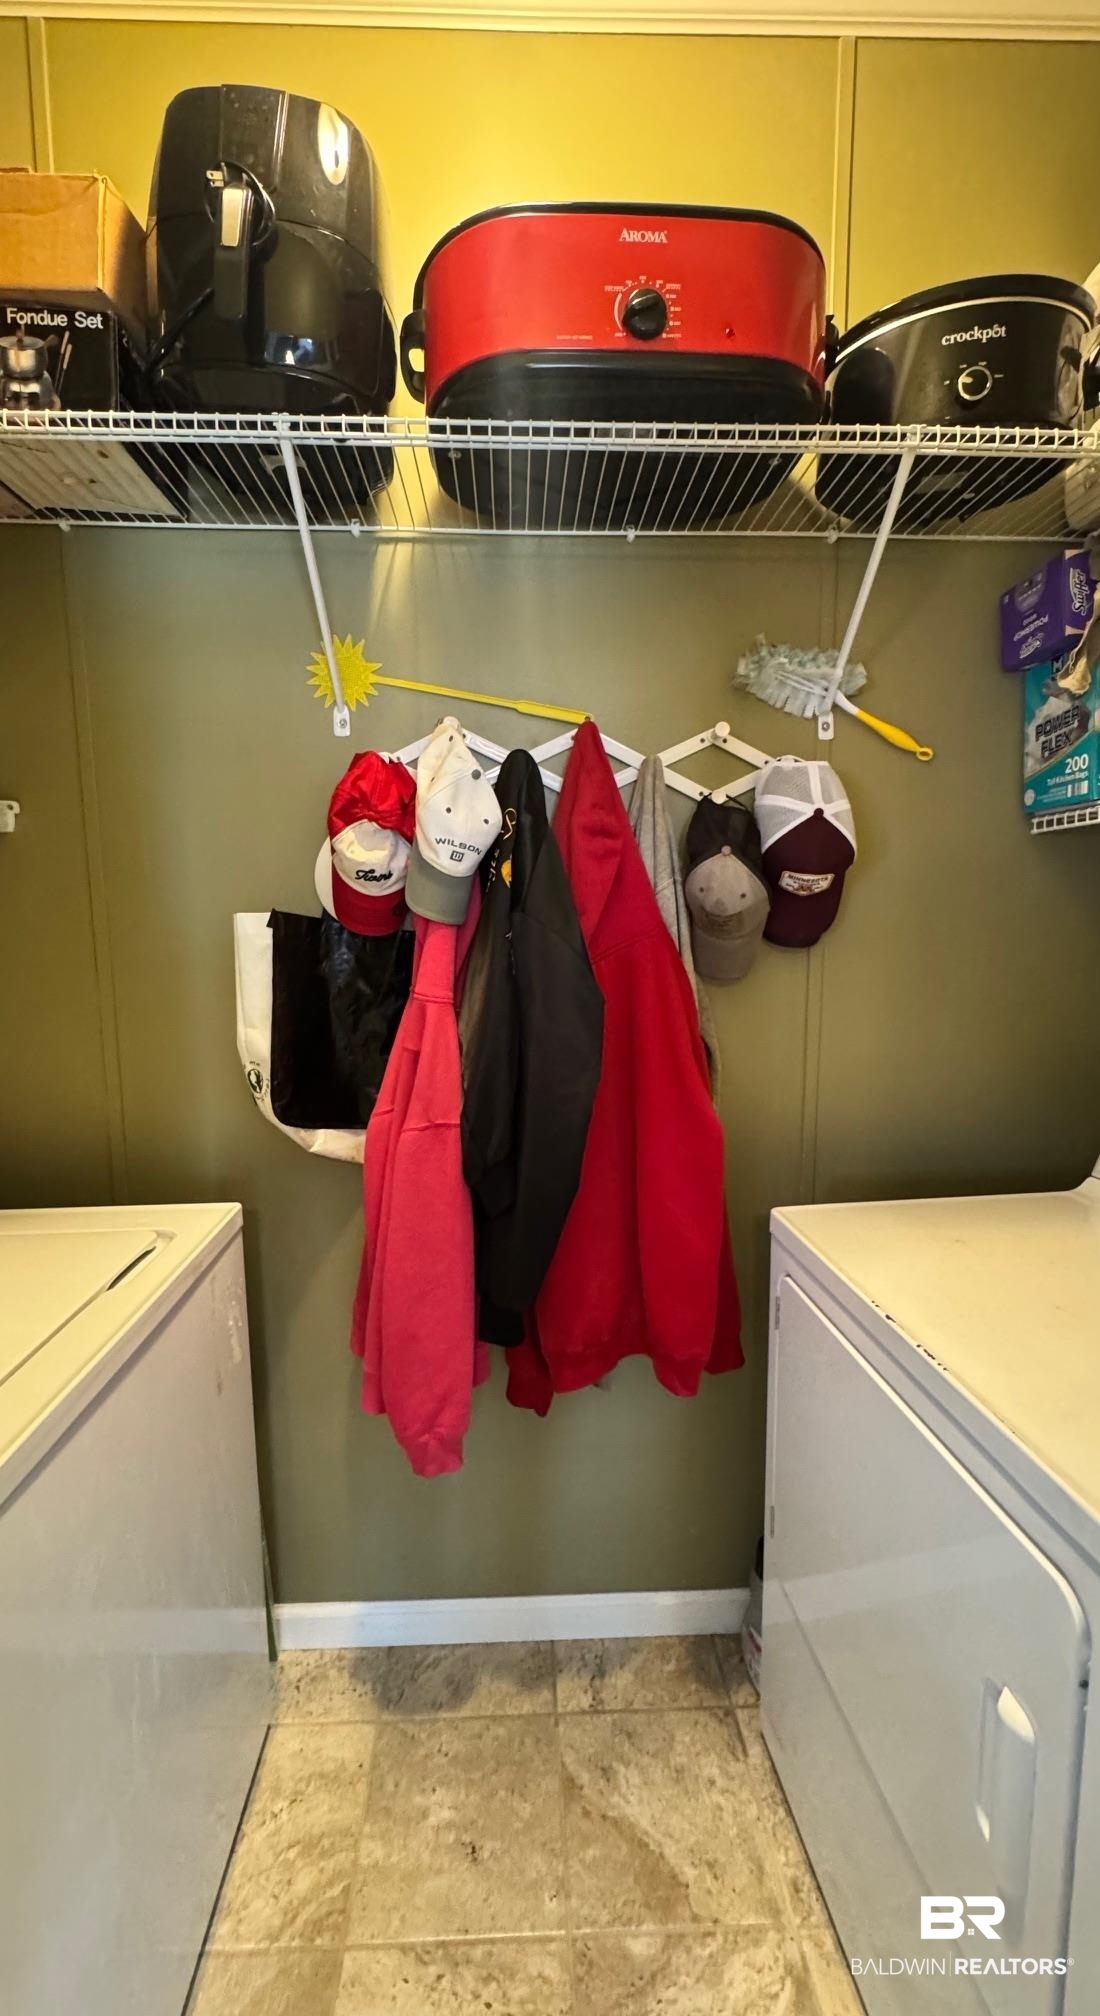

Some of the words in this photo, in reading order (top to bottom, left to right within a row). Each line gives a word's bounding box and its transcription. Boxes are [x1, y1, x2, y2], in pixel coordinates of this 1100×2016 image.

[618, 227, 668, 243] AROMA
[6, 308, 68, 328] Fondue
[74, 310, 104, 330] Set
[941, 324, 1007, 346] crockpot
[1069, 568, 1090, 616] Swiffer
[1035, 705, 1080, 742] POWER
[1041, 731, 1073, 760] FLEX
[1065, 753, 1089, 774] 200
[1075, 770, 1089, 780] Bags
[435, 837, 482, 856] WILSON
